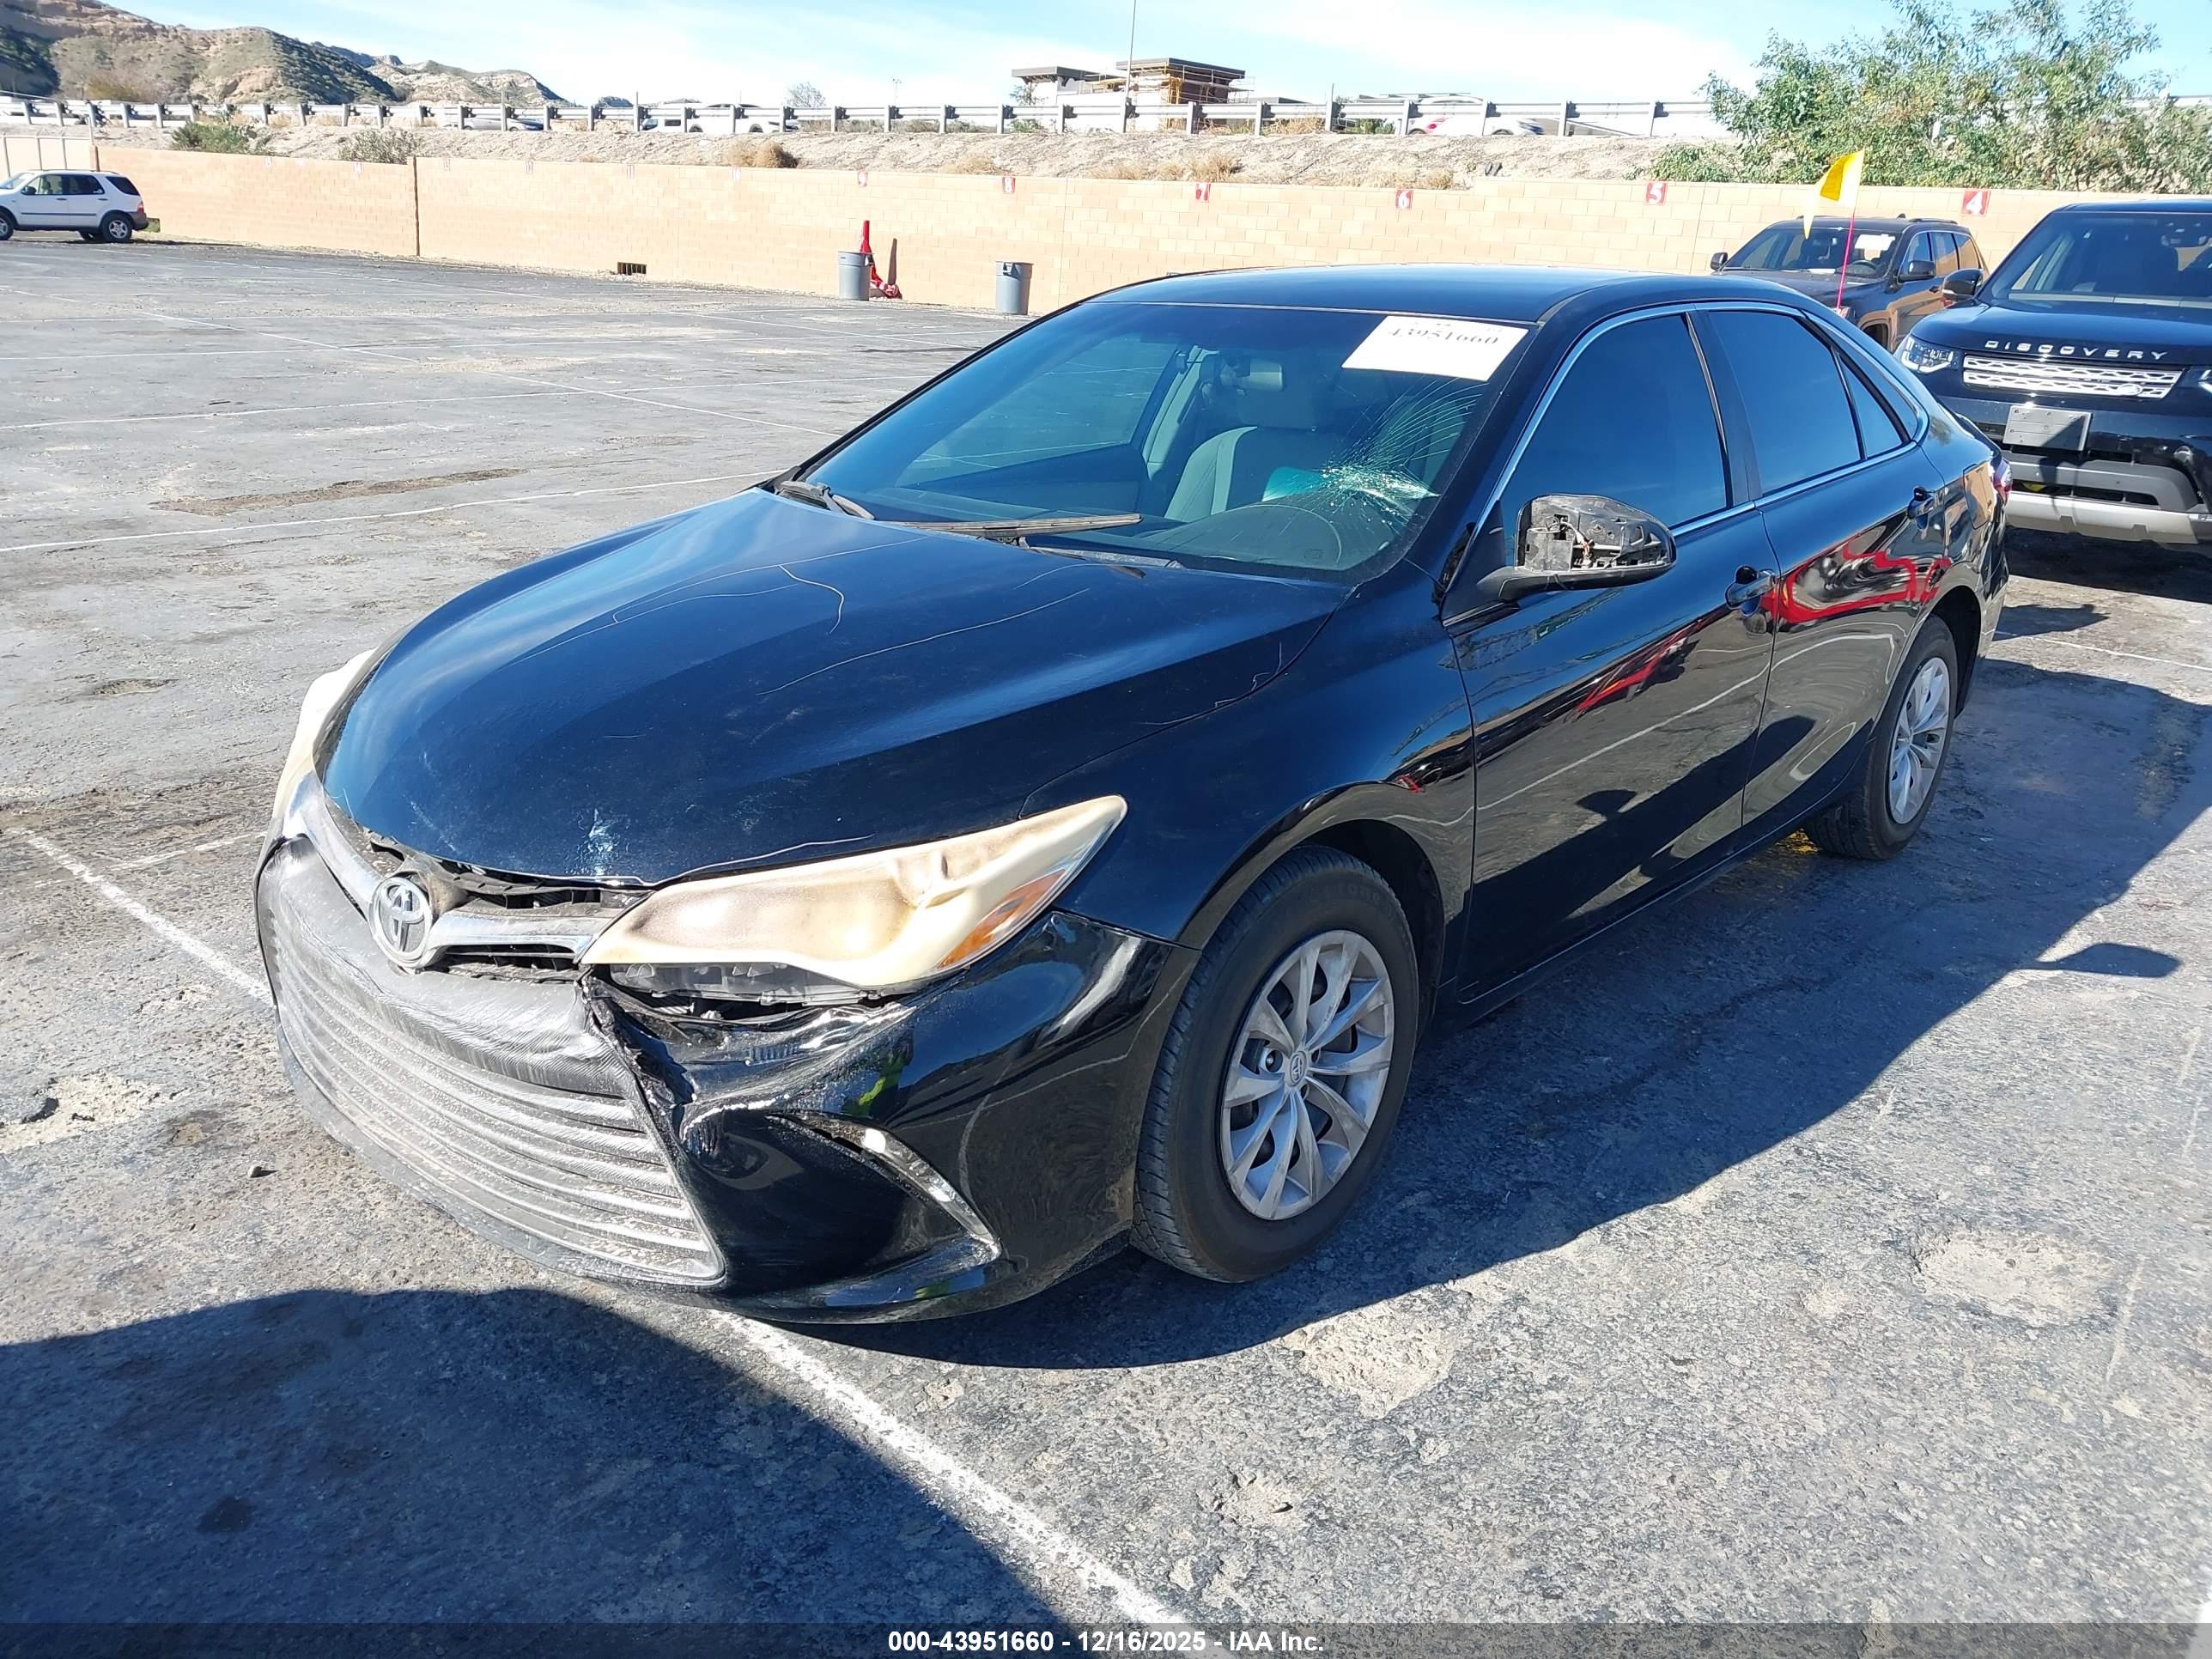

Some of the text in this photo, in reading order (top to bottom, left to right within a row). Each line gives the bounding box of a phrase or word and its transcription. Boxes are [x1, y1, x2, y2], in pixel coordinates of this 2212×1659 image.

[1398, 190, 1410, 210] 6
[1648, 183, 1662, 204] 5
[1965, 191, 1982, 214] 4
[1984, 340, 2168, 360] DISCOVERY
